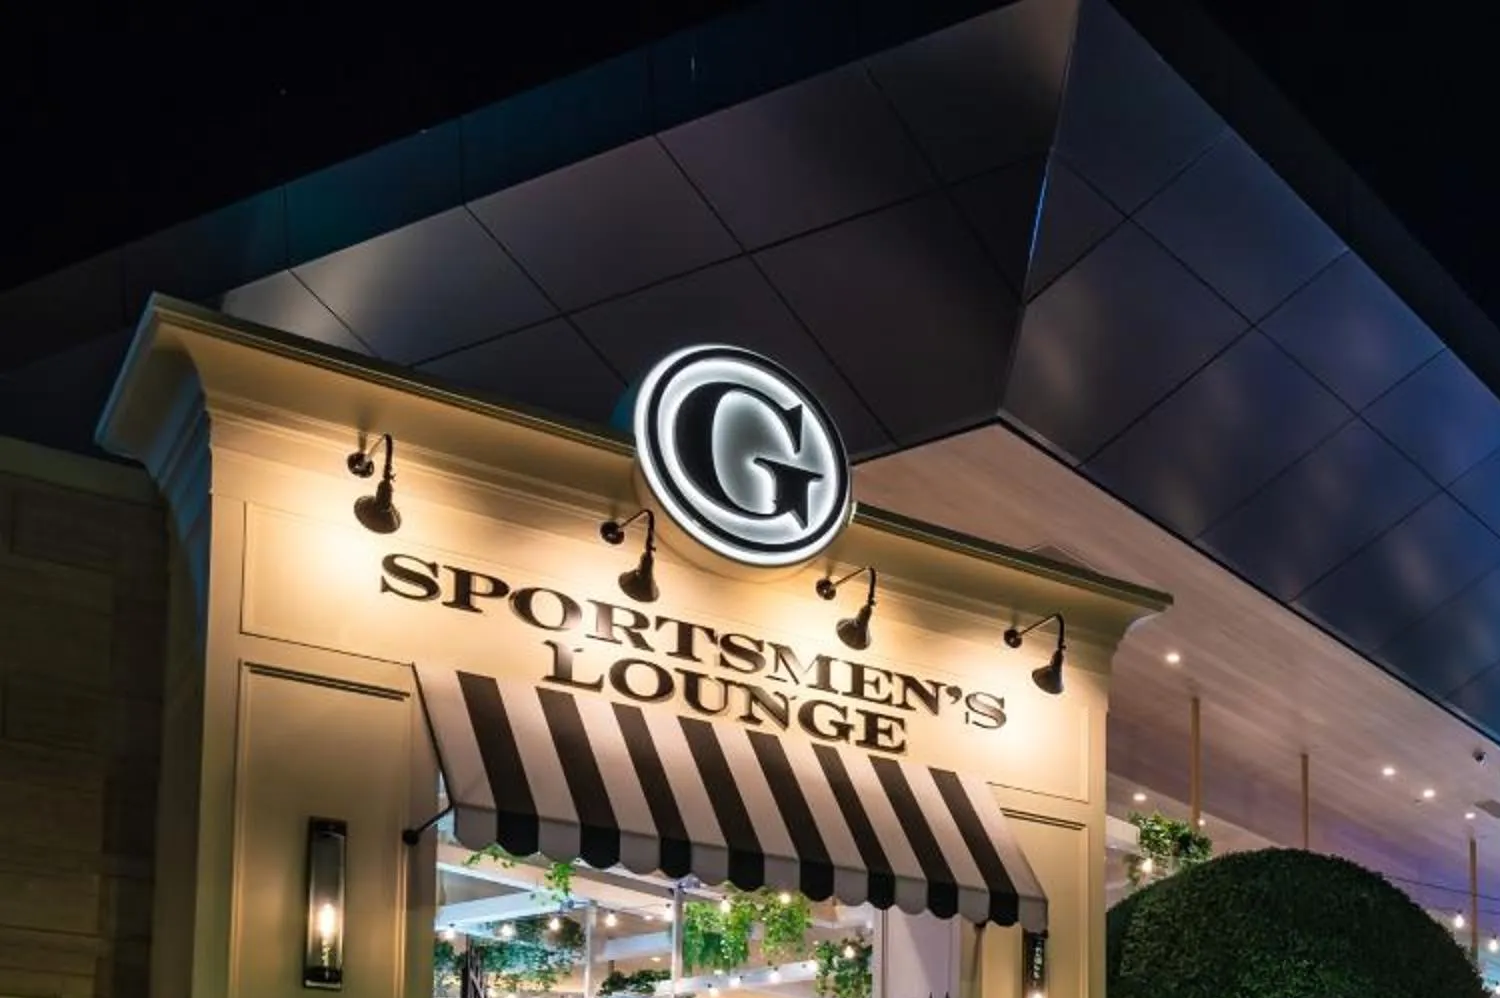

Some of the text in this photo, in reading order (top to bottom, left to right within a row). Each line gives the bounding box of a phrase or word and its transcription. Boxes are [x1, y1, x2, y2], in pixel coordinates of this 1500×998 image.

[674, 381, 823, 530] G
[380, 553, 1006, 729] SPORTSMEN'S
[543, 640, 906, 753] LOUNGE
